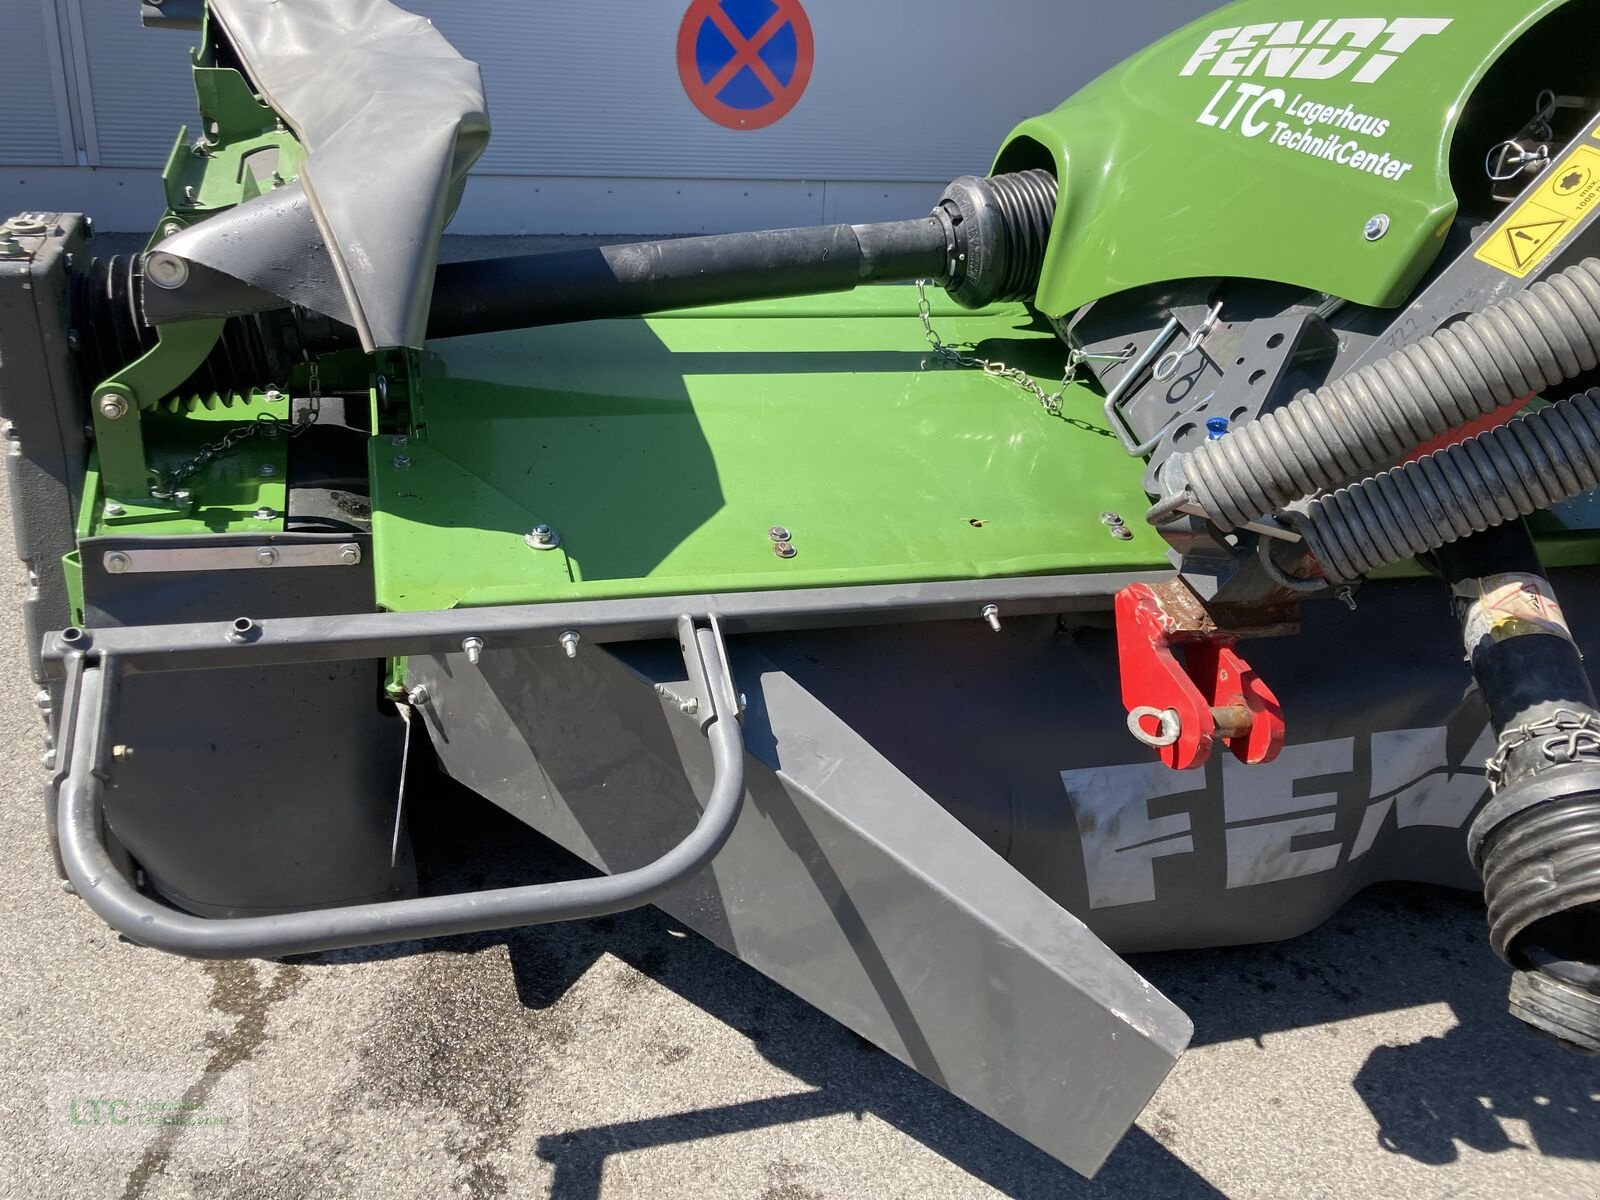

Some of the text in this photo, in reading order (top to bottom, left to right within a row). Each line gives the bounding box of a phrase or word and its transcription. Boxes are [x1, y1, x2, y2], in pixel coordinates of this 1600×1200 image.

[1179, 17, 1454, 84] FENDT
[1196, 80, 1286, 138] LTC
[1285, 93, 1391, 138] Lagerhaus
[1268, 121, 1413, 182] TechnikCenter
[1576, 192, 1596, 210] 1000
